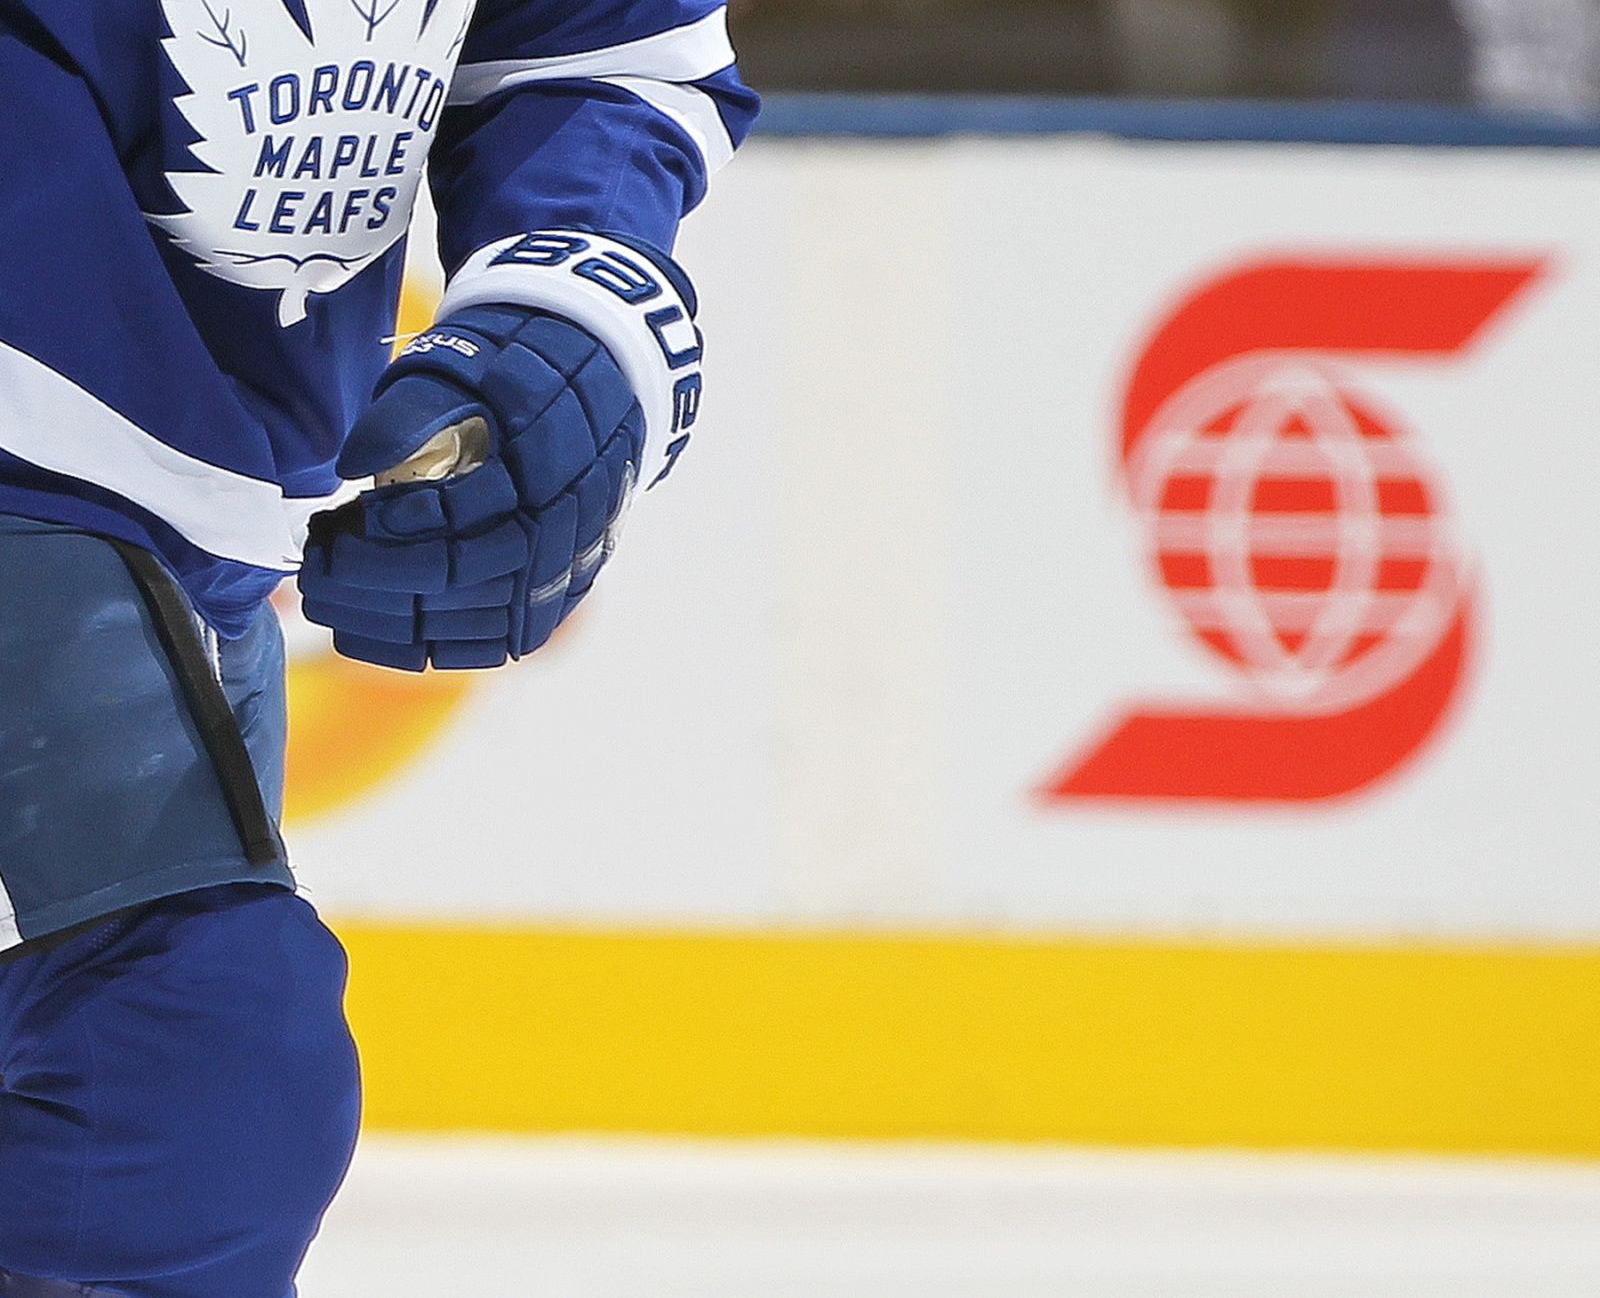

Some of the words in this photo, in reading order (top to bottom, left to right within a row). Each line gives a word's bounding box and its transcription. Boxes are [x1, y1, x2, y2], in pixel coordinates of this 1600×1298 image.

[227, 60, 446, 135] TORONTO
[253, 131, 414, 180] MAPLE
[232, 186, 397, 235] LEAFS
